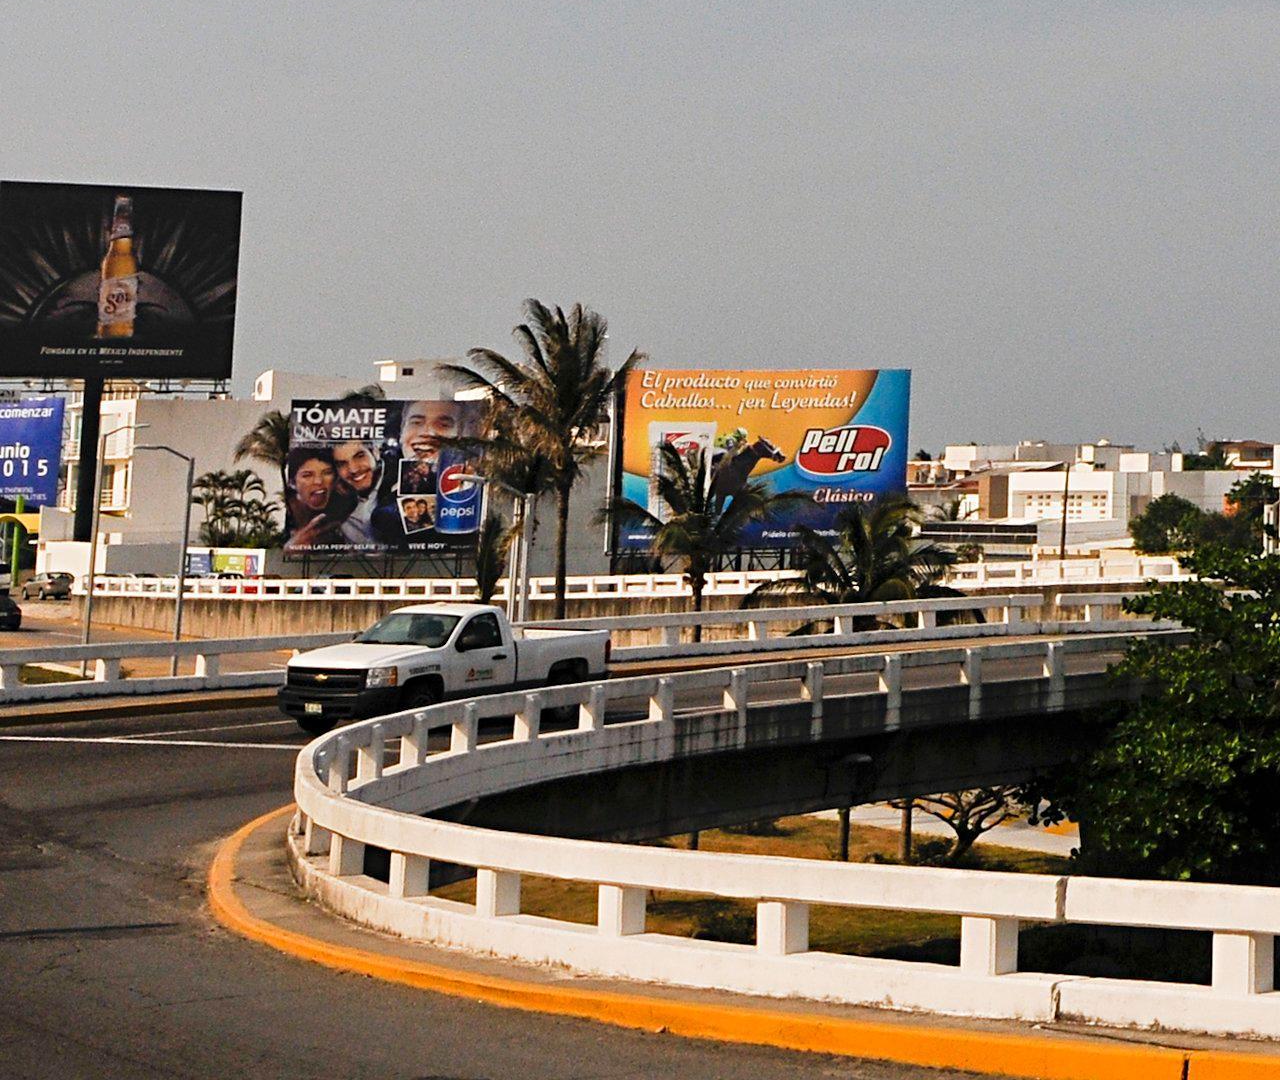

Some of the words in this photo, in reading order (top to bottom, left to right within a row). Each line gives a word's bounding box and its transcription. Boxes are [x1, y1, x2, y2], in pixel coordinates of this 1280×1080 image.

[642, 371, 662, 388] El
[663, 373, 741, 392] producto
[744, 378, 771, 392] que
[774, 374, 838, 389] convirtió
[0, 407, 54, 418] comenzar
[771, 390, 858, 414] Leyendas!
[293, 403, 386, 424] TÓMATE
[293, 426, 327, 439] UNA
[331, 426, 385, 438] SELFIE
[801, 429, 858, 453] Pell
[836, 447, 884, 471] rol
[813, 488, 874, 503] Clásico
[440, 505, 475, 519] pepsi
